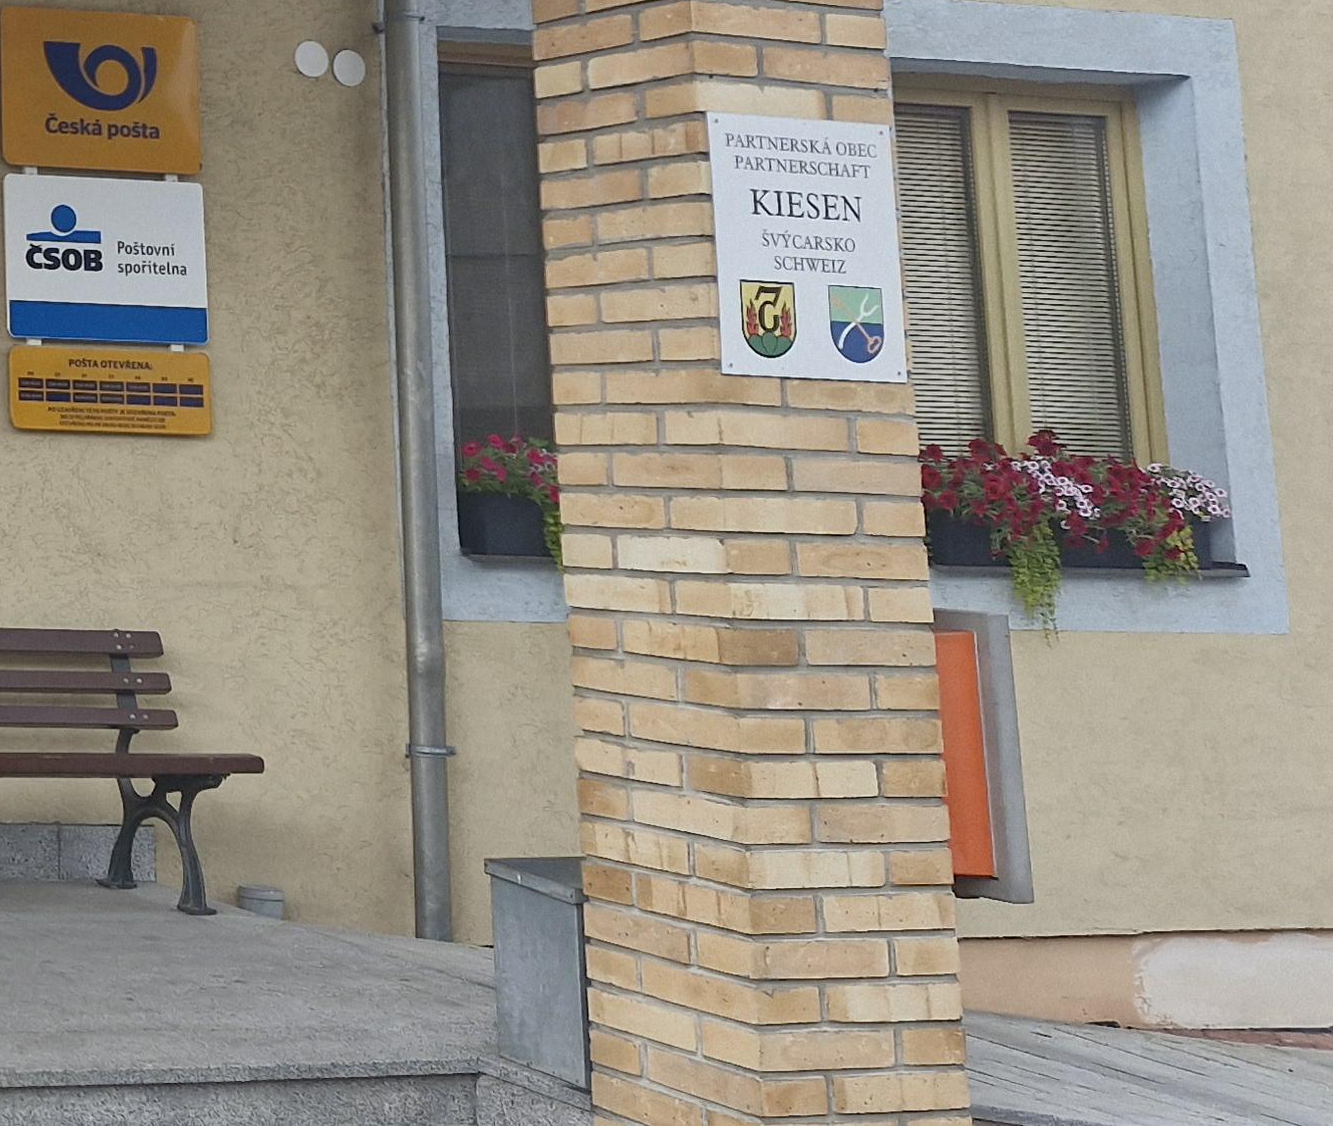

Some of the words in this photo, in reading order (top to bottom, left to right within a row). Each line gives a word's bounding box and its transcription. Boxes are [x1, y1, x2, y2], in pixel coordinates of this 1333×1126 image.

[44, 113, 102, 136] Česká
[107, 121, 161, 140] pošta
[724, 132, 832, 155] PARTNERSKÁ
[835, 141, 878, 159] OBEC
[734, 154, 871, 179] PARTNERSCHAFT
[749, 188, 863, 222] KIESEN
[117, 240, 175, 257] Poštovní
[761, 230, 856, 253] ŠVÝCARSKO
[25, 243, 104, 272] ČSOB
[117, 260, 188, 277] spořitelna
[773, 255, 847, 275] SCHWEIZ
[68, 358, 98, 368] POŠTA
[100, 359, 153, 370] OTEVŘENA:
